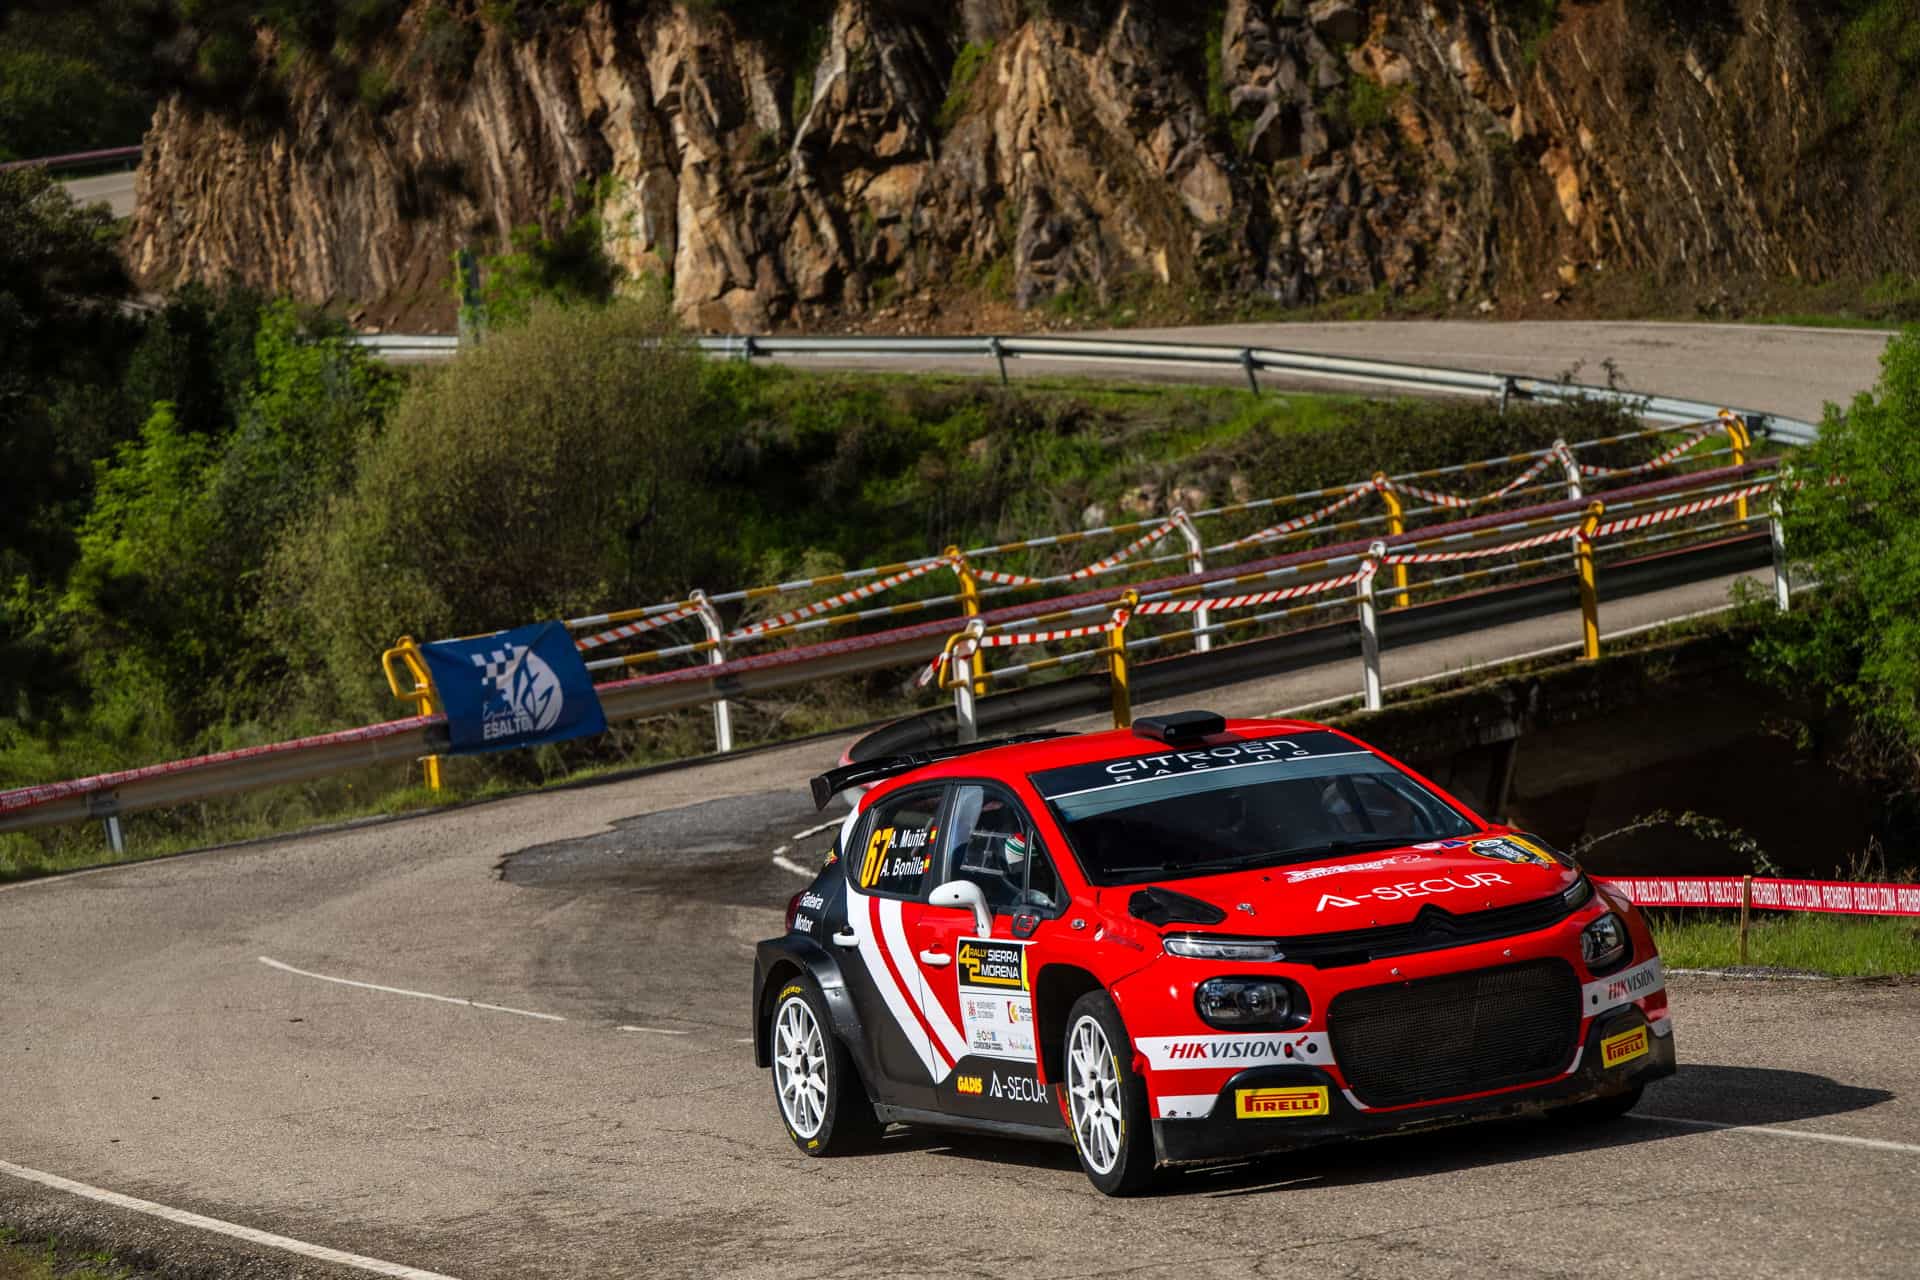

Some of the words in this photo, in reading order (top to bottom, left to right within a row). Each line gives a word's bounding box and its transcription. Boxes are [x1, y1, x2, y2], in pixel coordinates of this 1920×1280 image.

[1106, 740, 1299, 774] CITROËN
[1114, 749, 1309, 782] RACING
[900, 828, 928, 847] Muñiz
[861, 827, 895, 888] 67
[880, 858, 890, 876] A.
[892, 857, 924, 876] Bonilla
[1316, 872, 1512, 912] A-SECUR
[794, 913, 814, 933] Motor
[987, 950, 1019, 962] SIERRA
[981, 965, 1019, 979] MORENA
[1608, 968, 1655, 1000] HIKVISION
[1169, 1041, 1282, 1058] HIKVISION
[1606, 1033, 1643, 1060] PIRELLI
[957, 1075, 983, 1094] GADIS
[989, 1070, 1049, 1104] A-SECUR
[1244, 1092, 1319, 1112] PIRELLI
